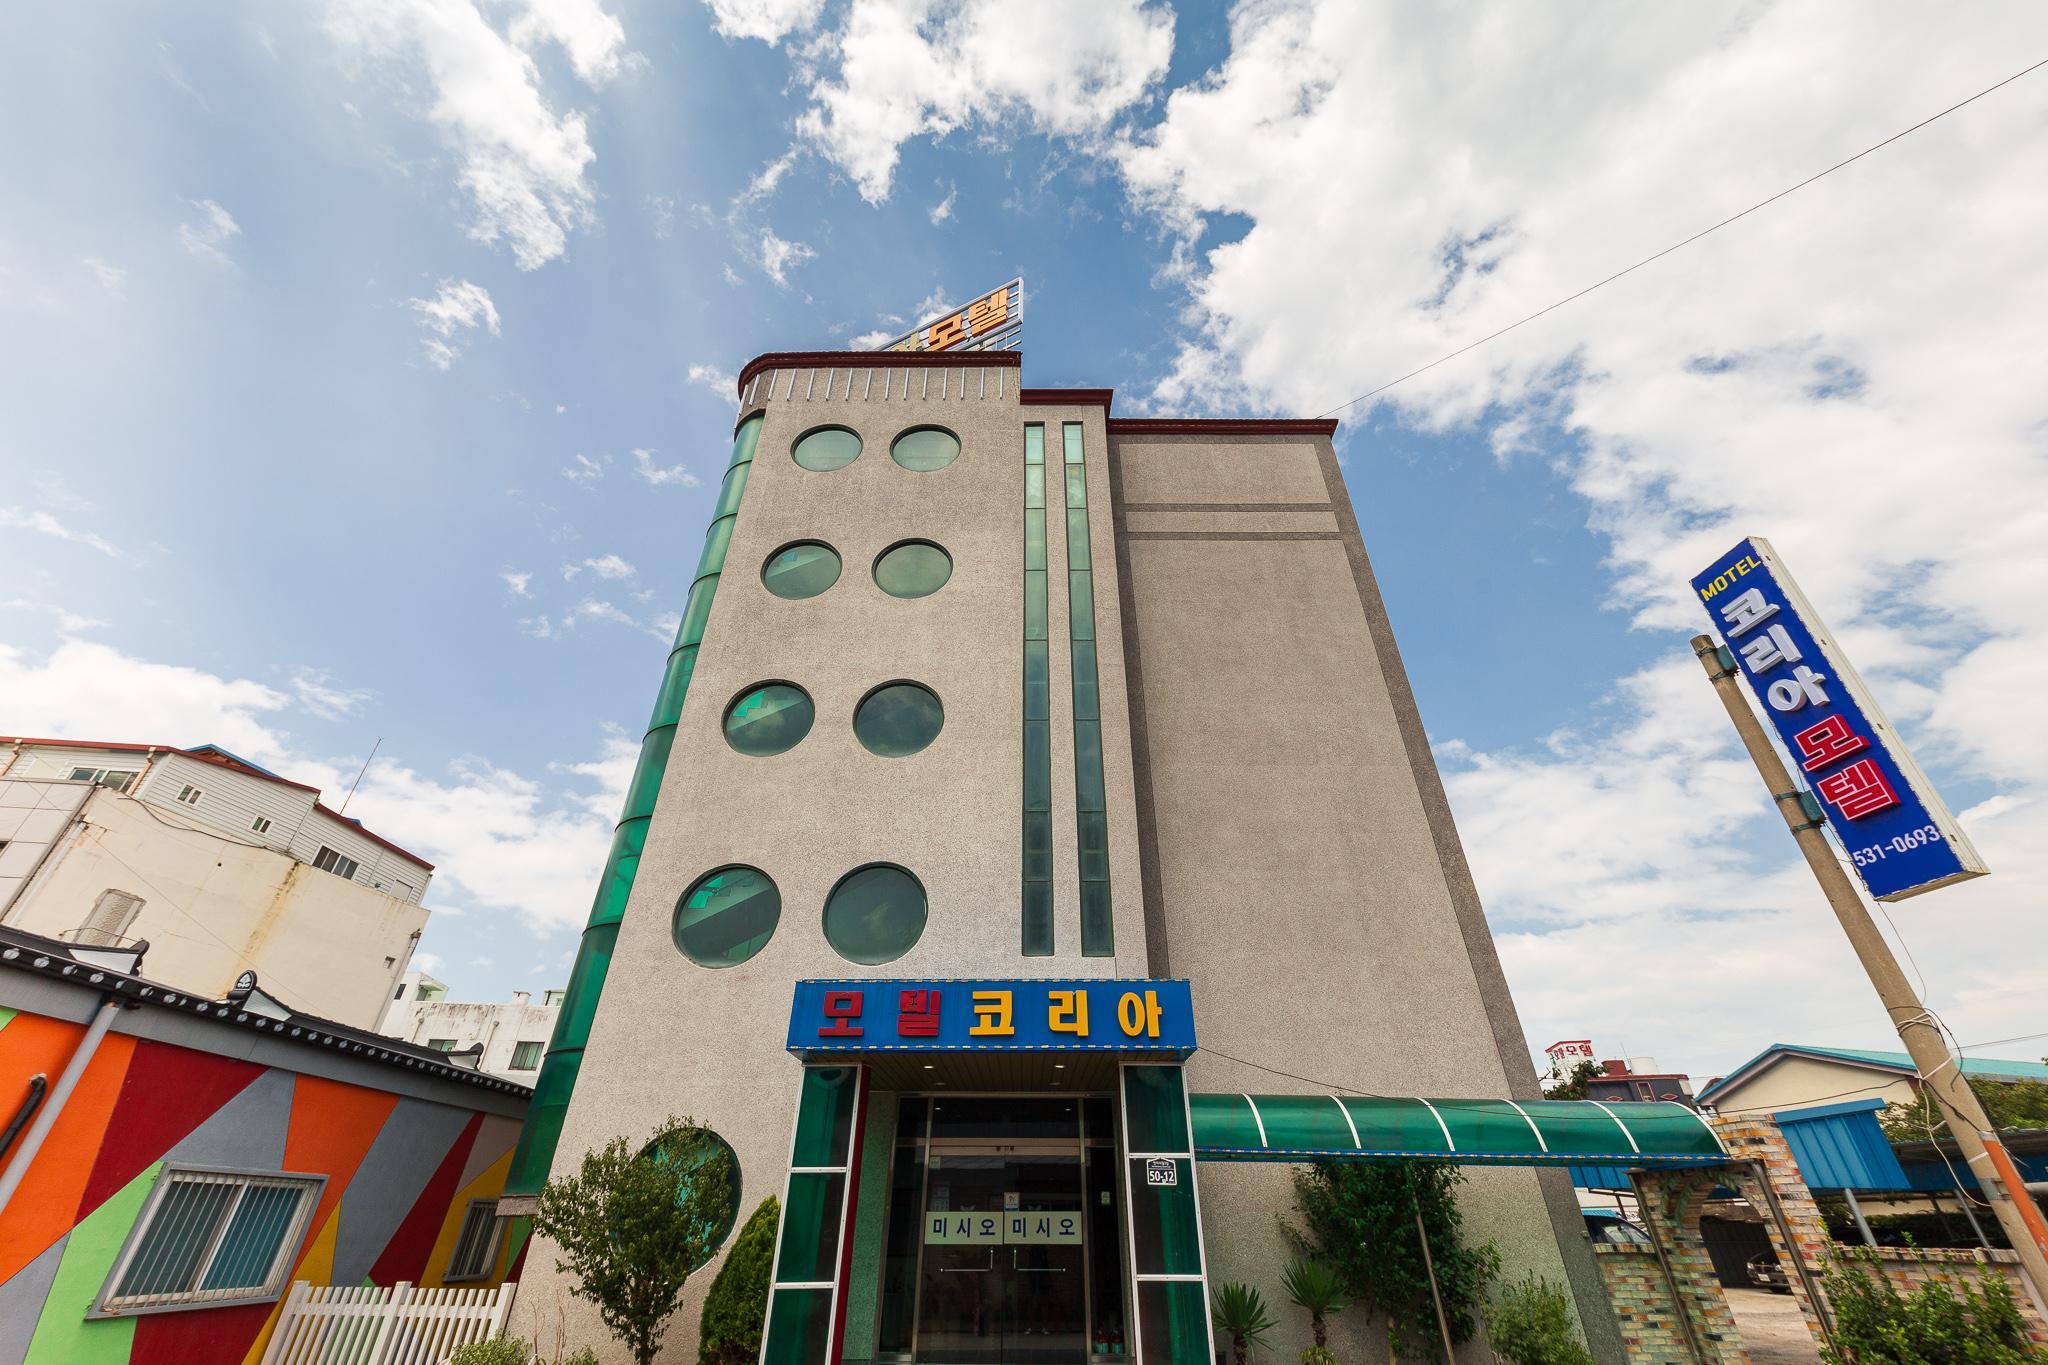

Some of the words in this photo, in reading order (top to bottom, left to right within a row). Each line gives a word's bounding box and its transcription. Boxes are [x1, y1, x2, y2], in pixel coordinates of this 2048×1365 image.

[924, 288, 1009, 351] 모텔
[1700, 555, 1761, 602] MOTEL
[1720, 587, 1831, 712] 코리아
[1794, 714, 1901, 821] 모텔
[1852, 825, 1941, 867] 531-0693
[818, 990, 942, 1037] 모텔
[969, 990, 1163, 1037] 코리아
[1149, 1170, 1175, 1182] 50-12
[933, 1217, 996, 1238] 미시오
[1012, 1217, 1075, 1238] 미시오
